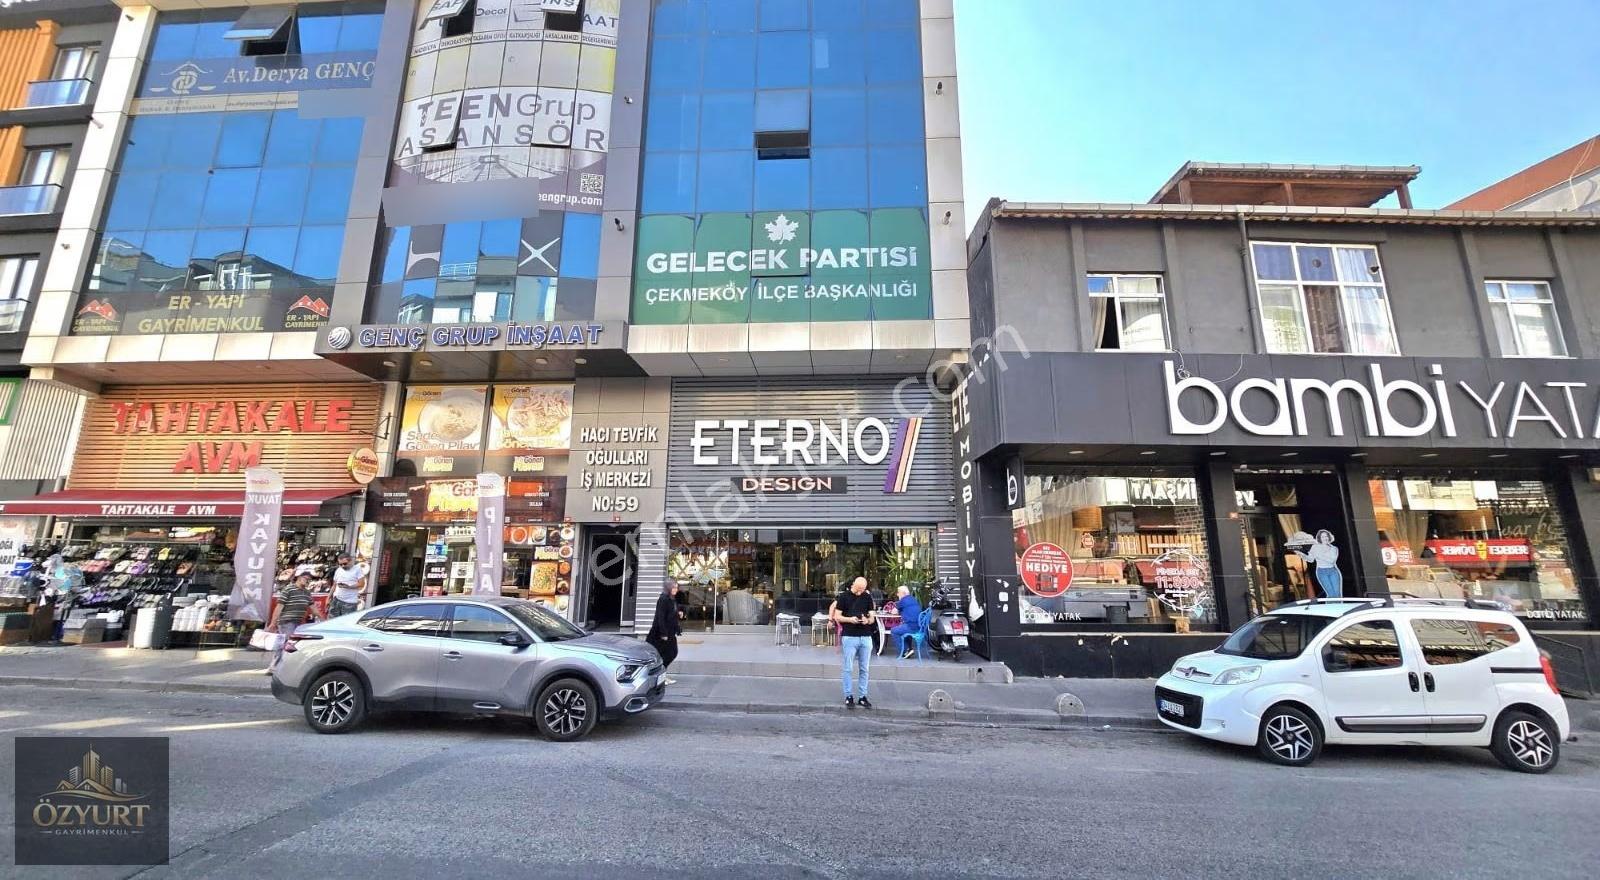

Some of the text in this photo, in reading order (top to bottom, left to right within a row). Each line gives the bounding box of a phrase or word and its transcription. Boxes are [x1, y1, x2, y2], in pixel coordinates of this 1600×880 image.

[224, 61, 377, 84] Av.Derya GENÇ
[418, 93, 596, 128] TEENGrup
[399, 120, 606, 159] ASANSÖR
[646, 249, 790, 274] GELECEK
[168, 295, 192, 311] ER
[645, 279, 917, 305] ÇEKMEKÖY İLÇE BAŞKANLIĞI
[137, 315, 265, 334] GAYRİMENKUL
[358, 321, 603, 350] GENÇ GRUP İNŞAAT
[1163, 360, 1600, 438] bambi YAT
[112, 399, 352, 434] TAHTAKALE
[580, 423, 659, 443] HACI TEVFİK
[689, 416, 891, 466] ETERNO
[172, 441, 265, 474] AVM
[585, 448, 649, 466] OĞULLARI
[580, 468, 652, 492] İŞ MERKEZİ
[100, 503, 217, 516] TAHTAKALE AVM
[591, 495, 640, 513] NO:59
[1052, 612, 1082, 621] YATAK
[1556, 609, 1585, 620] YATAK
